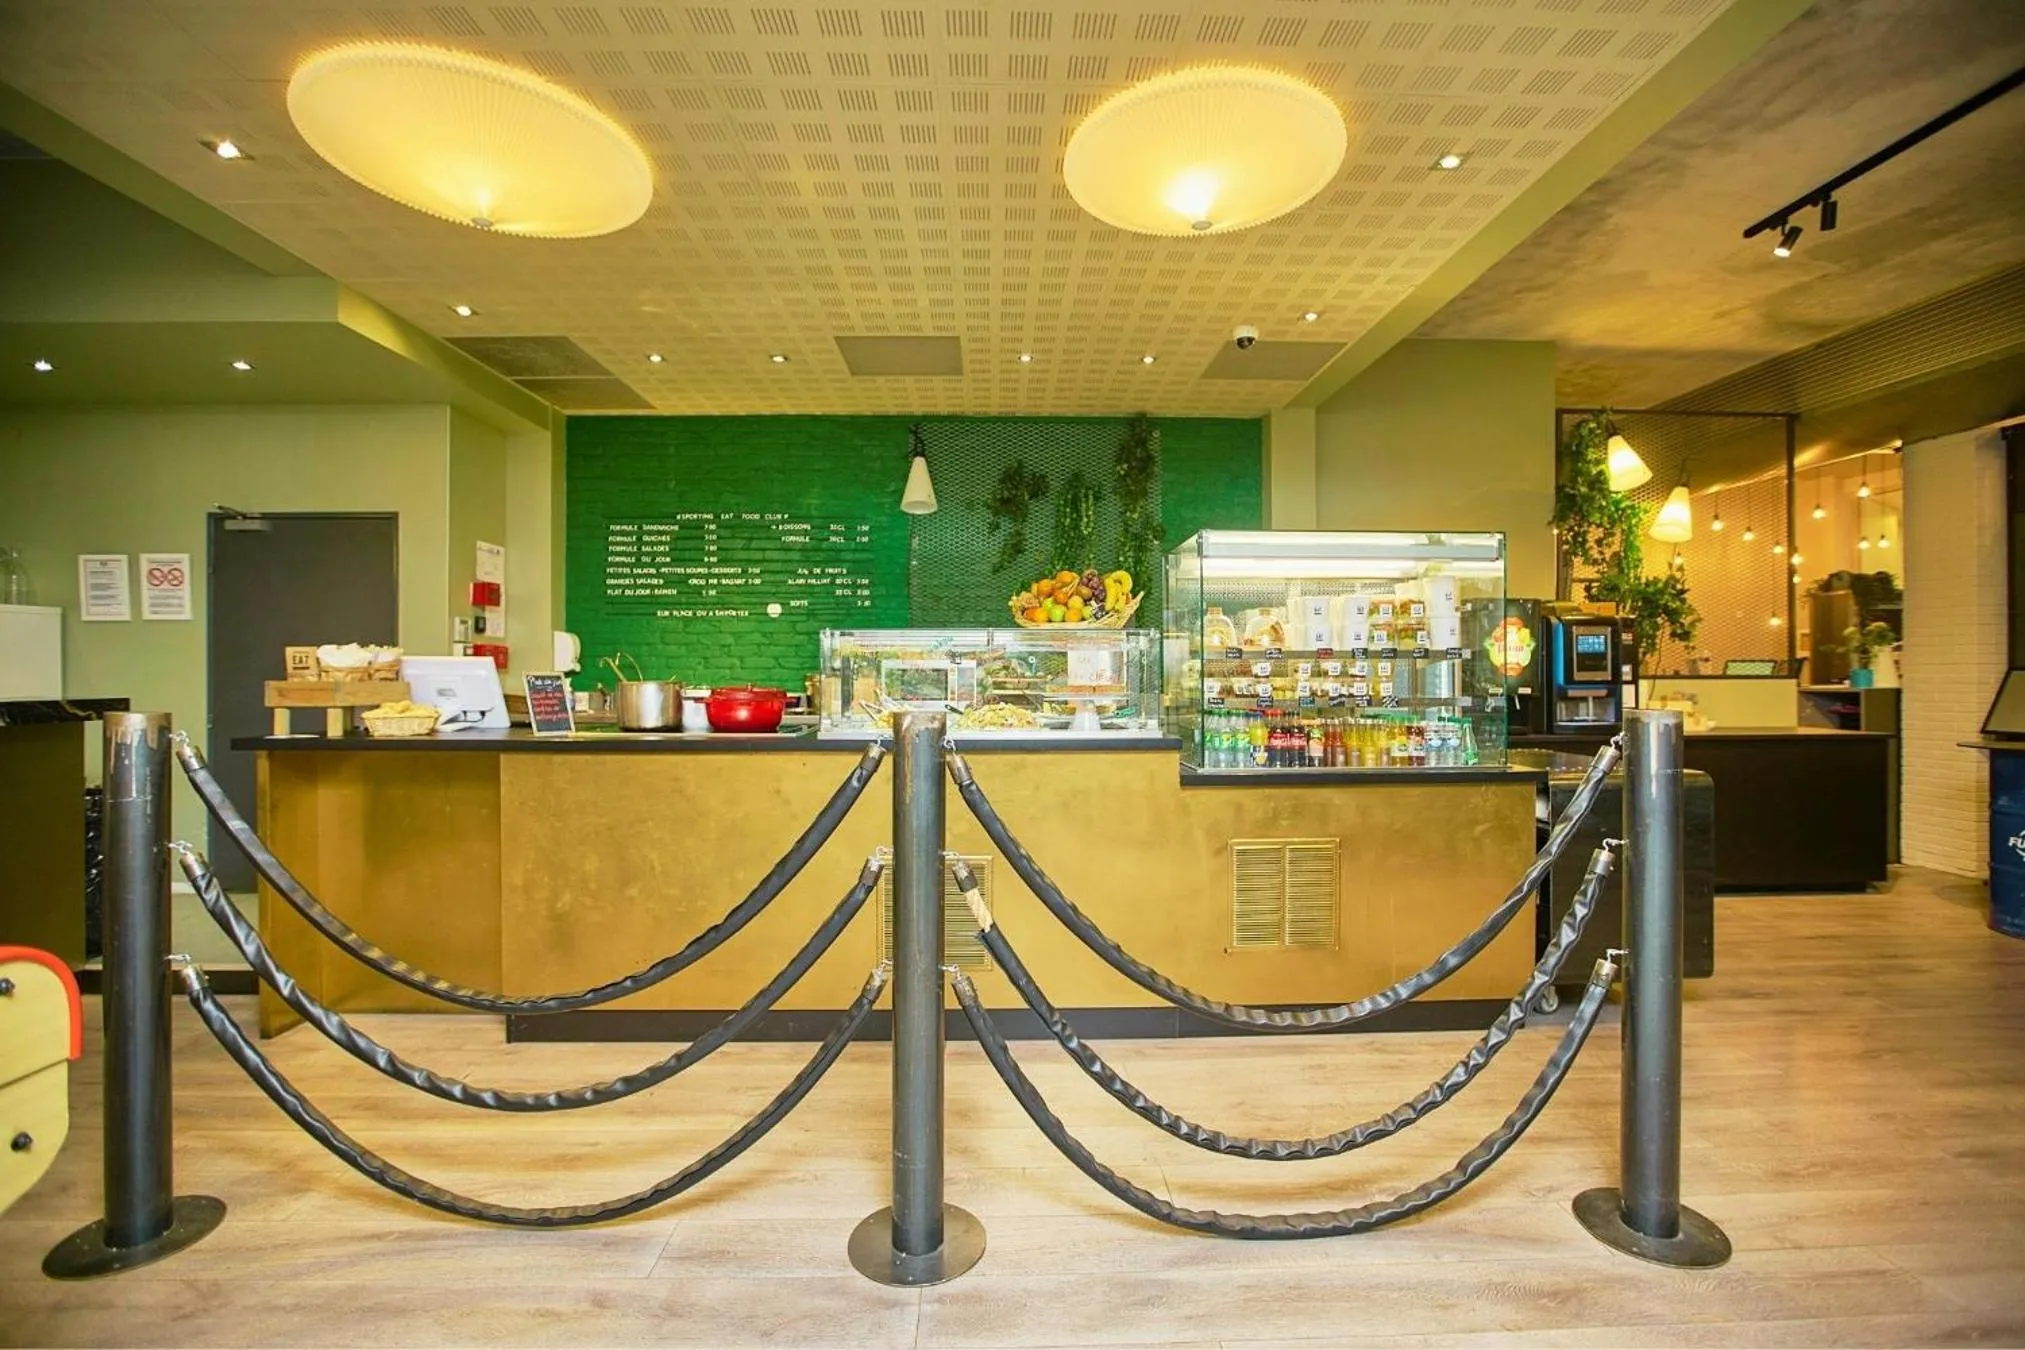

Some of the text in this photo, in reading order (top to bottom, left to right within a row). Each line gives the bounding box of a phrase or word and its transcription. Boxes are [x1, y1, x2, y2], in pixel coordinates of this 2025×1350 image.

[608, 534, 637, 542] FORMULE
[642, 534, 671, 542] QUICHES
[781, 535, 810, 543] FORMULE
[813, 567, 822, 575] DE
[825, 567, 848, 575] FRUITS
[656, 609, 671, 617] SUR
[673, 609, 693, 617] PLACE
[696, 609, 708, 617] OU
[292, 655, 310, 665] EAT
